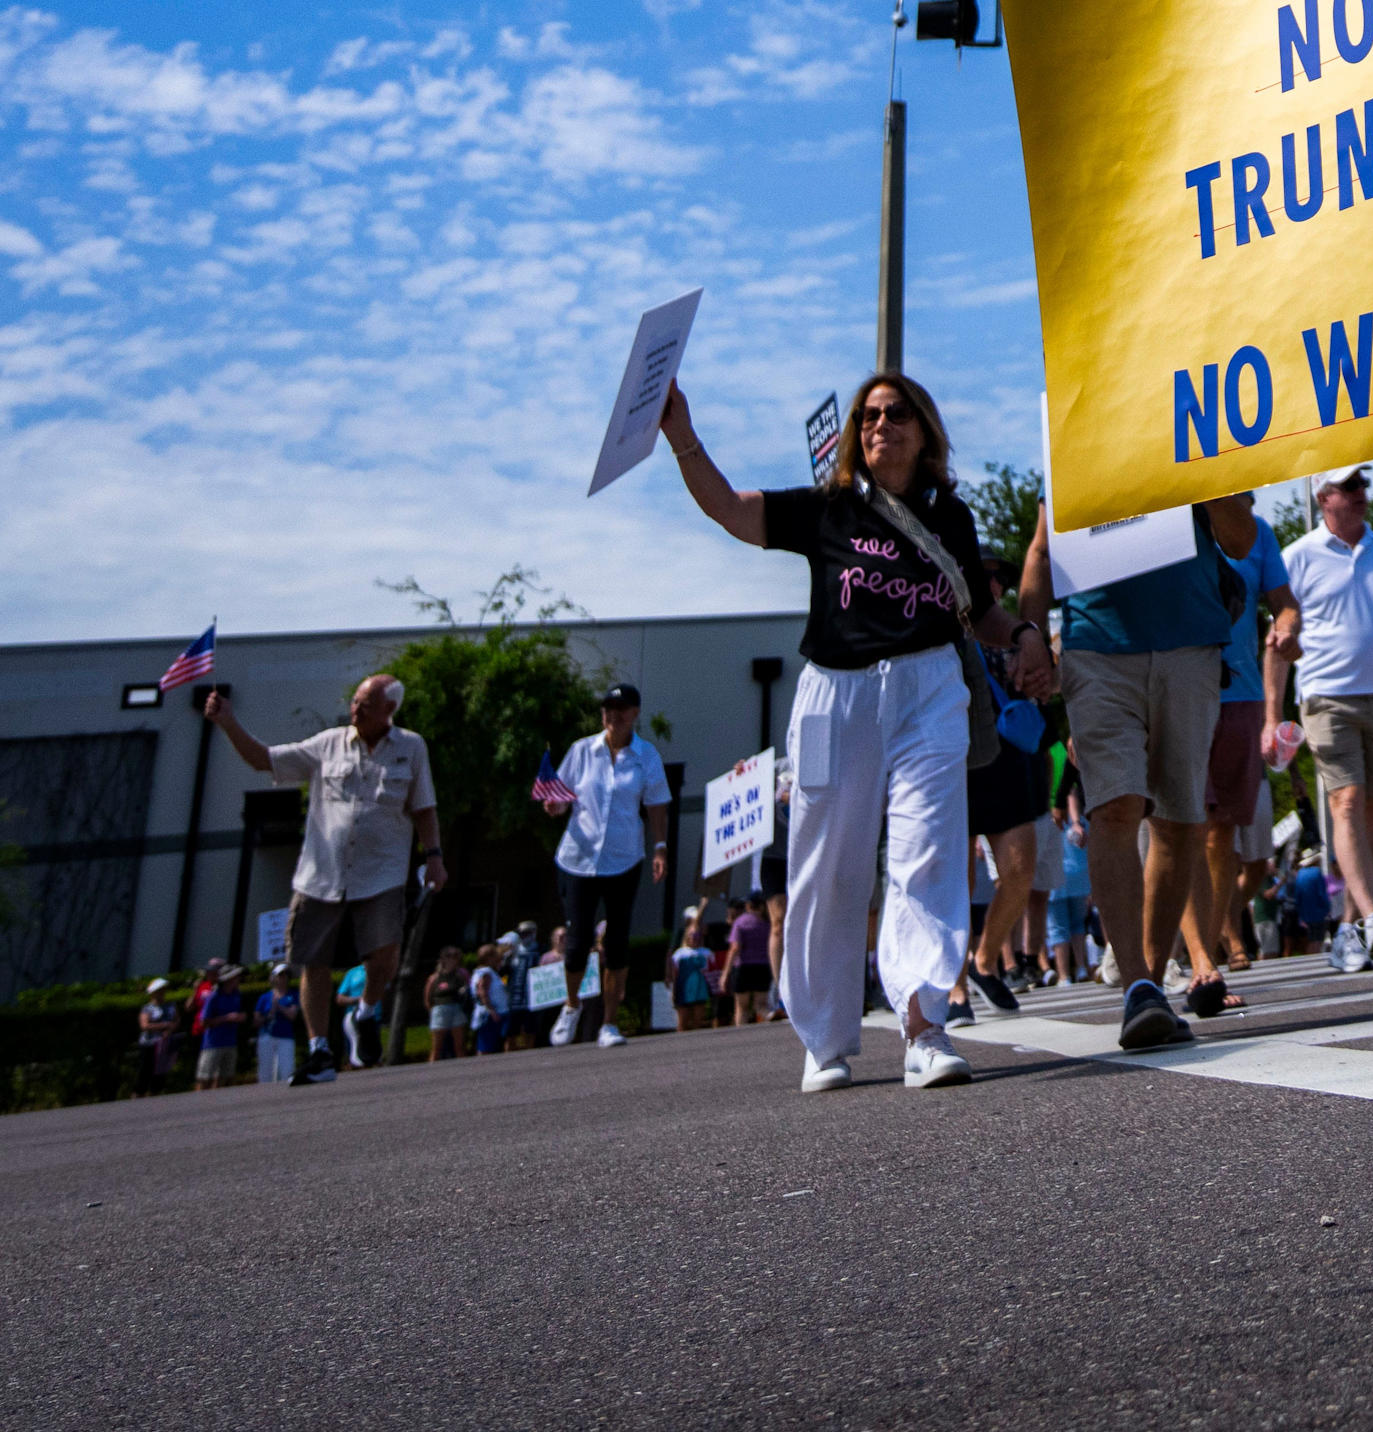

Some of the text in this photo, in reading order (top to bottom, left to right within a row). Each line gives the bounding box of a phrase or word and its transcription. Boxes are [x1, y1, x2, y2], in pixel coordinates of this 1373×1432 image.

[808, 401, 836, 438] WE THE
[1174, 345, 1273, 463] NO
[810, 417, 838, 455] PEOPLE
[850, 537, 900, 560] we
[747, 785, 761, 804] ON
[714, 805, 764, 844] THE LIST
